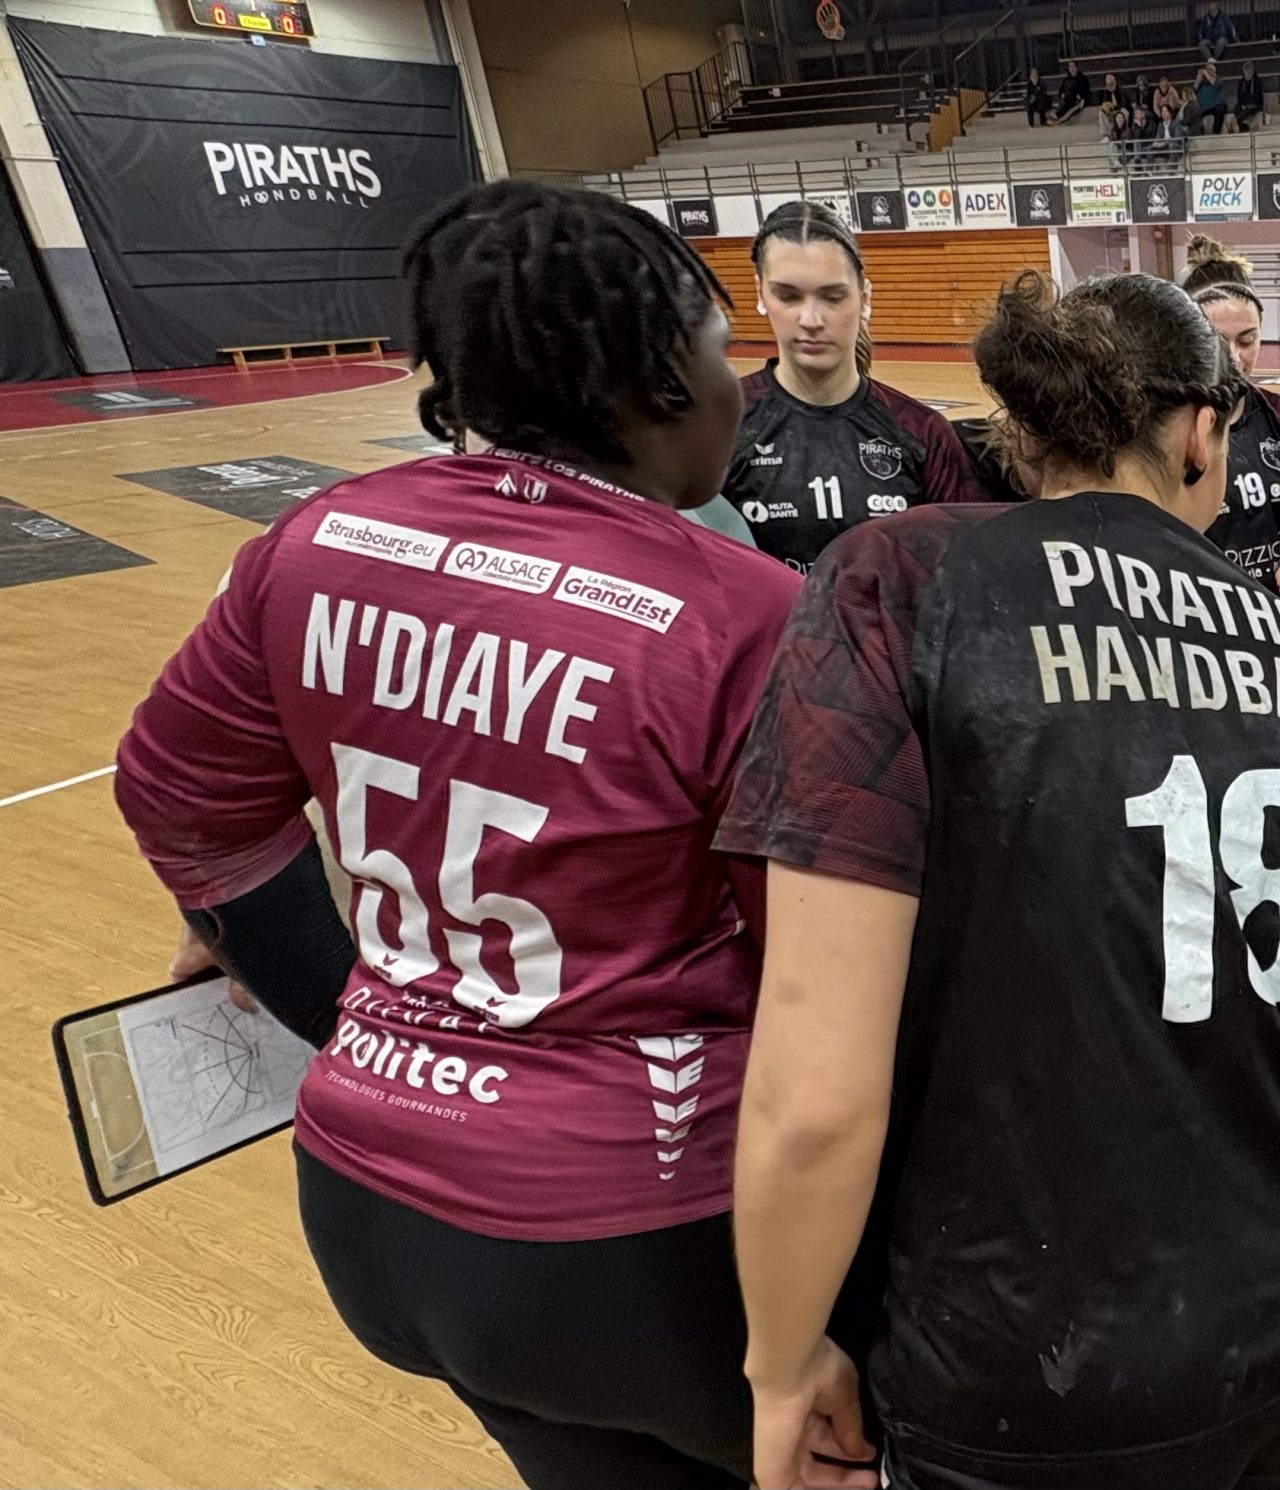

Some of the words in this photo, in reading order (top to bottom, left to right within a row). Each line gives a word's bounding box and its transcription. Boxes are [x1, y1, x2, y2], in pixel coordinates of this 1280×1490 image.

[203, 141, 382, 198] PIRATHS
[1202, 176, 1246, 192] POLY
[965, 193, 1007, 212] ADEX
[1199, 192, 1242, 207] RACK
[858, 442, 902, 460] PIRATHS
[768, 502, 795, 510] MUTA
[807, 475, 844, 519] 11
[1233, 472, 1267, 510] 19
[768, 508, 799, 519] SANTÉ
[324, 519, 436, 559] Strasbourg.eu
[485, 556, 552, 583] ALSACE
[302, 592, 615, 764] N'DIAYE
[330, 742, 563, 1029] 55
[324, 1069, 386, 1101] TECHNOLOGIES
[387, 1094, 469, 1123] GOURMANDES
